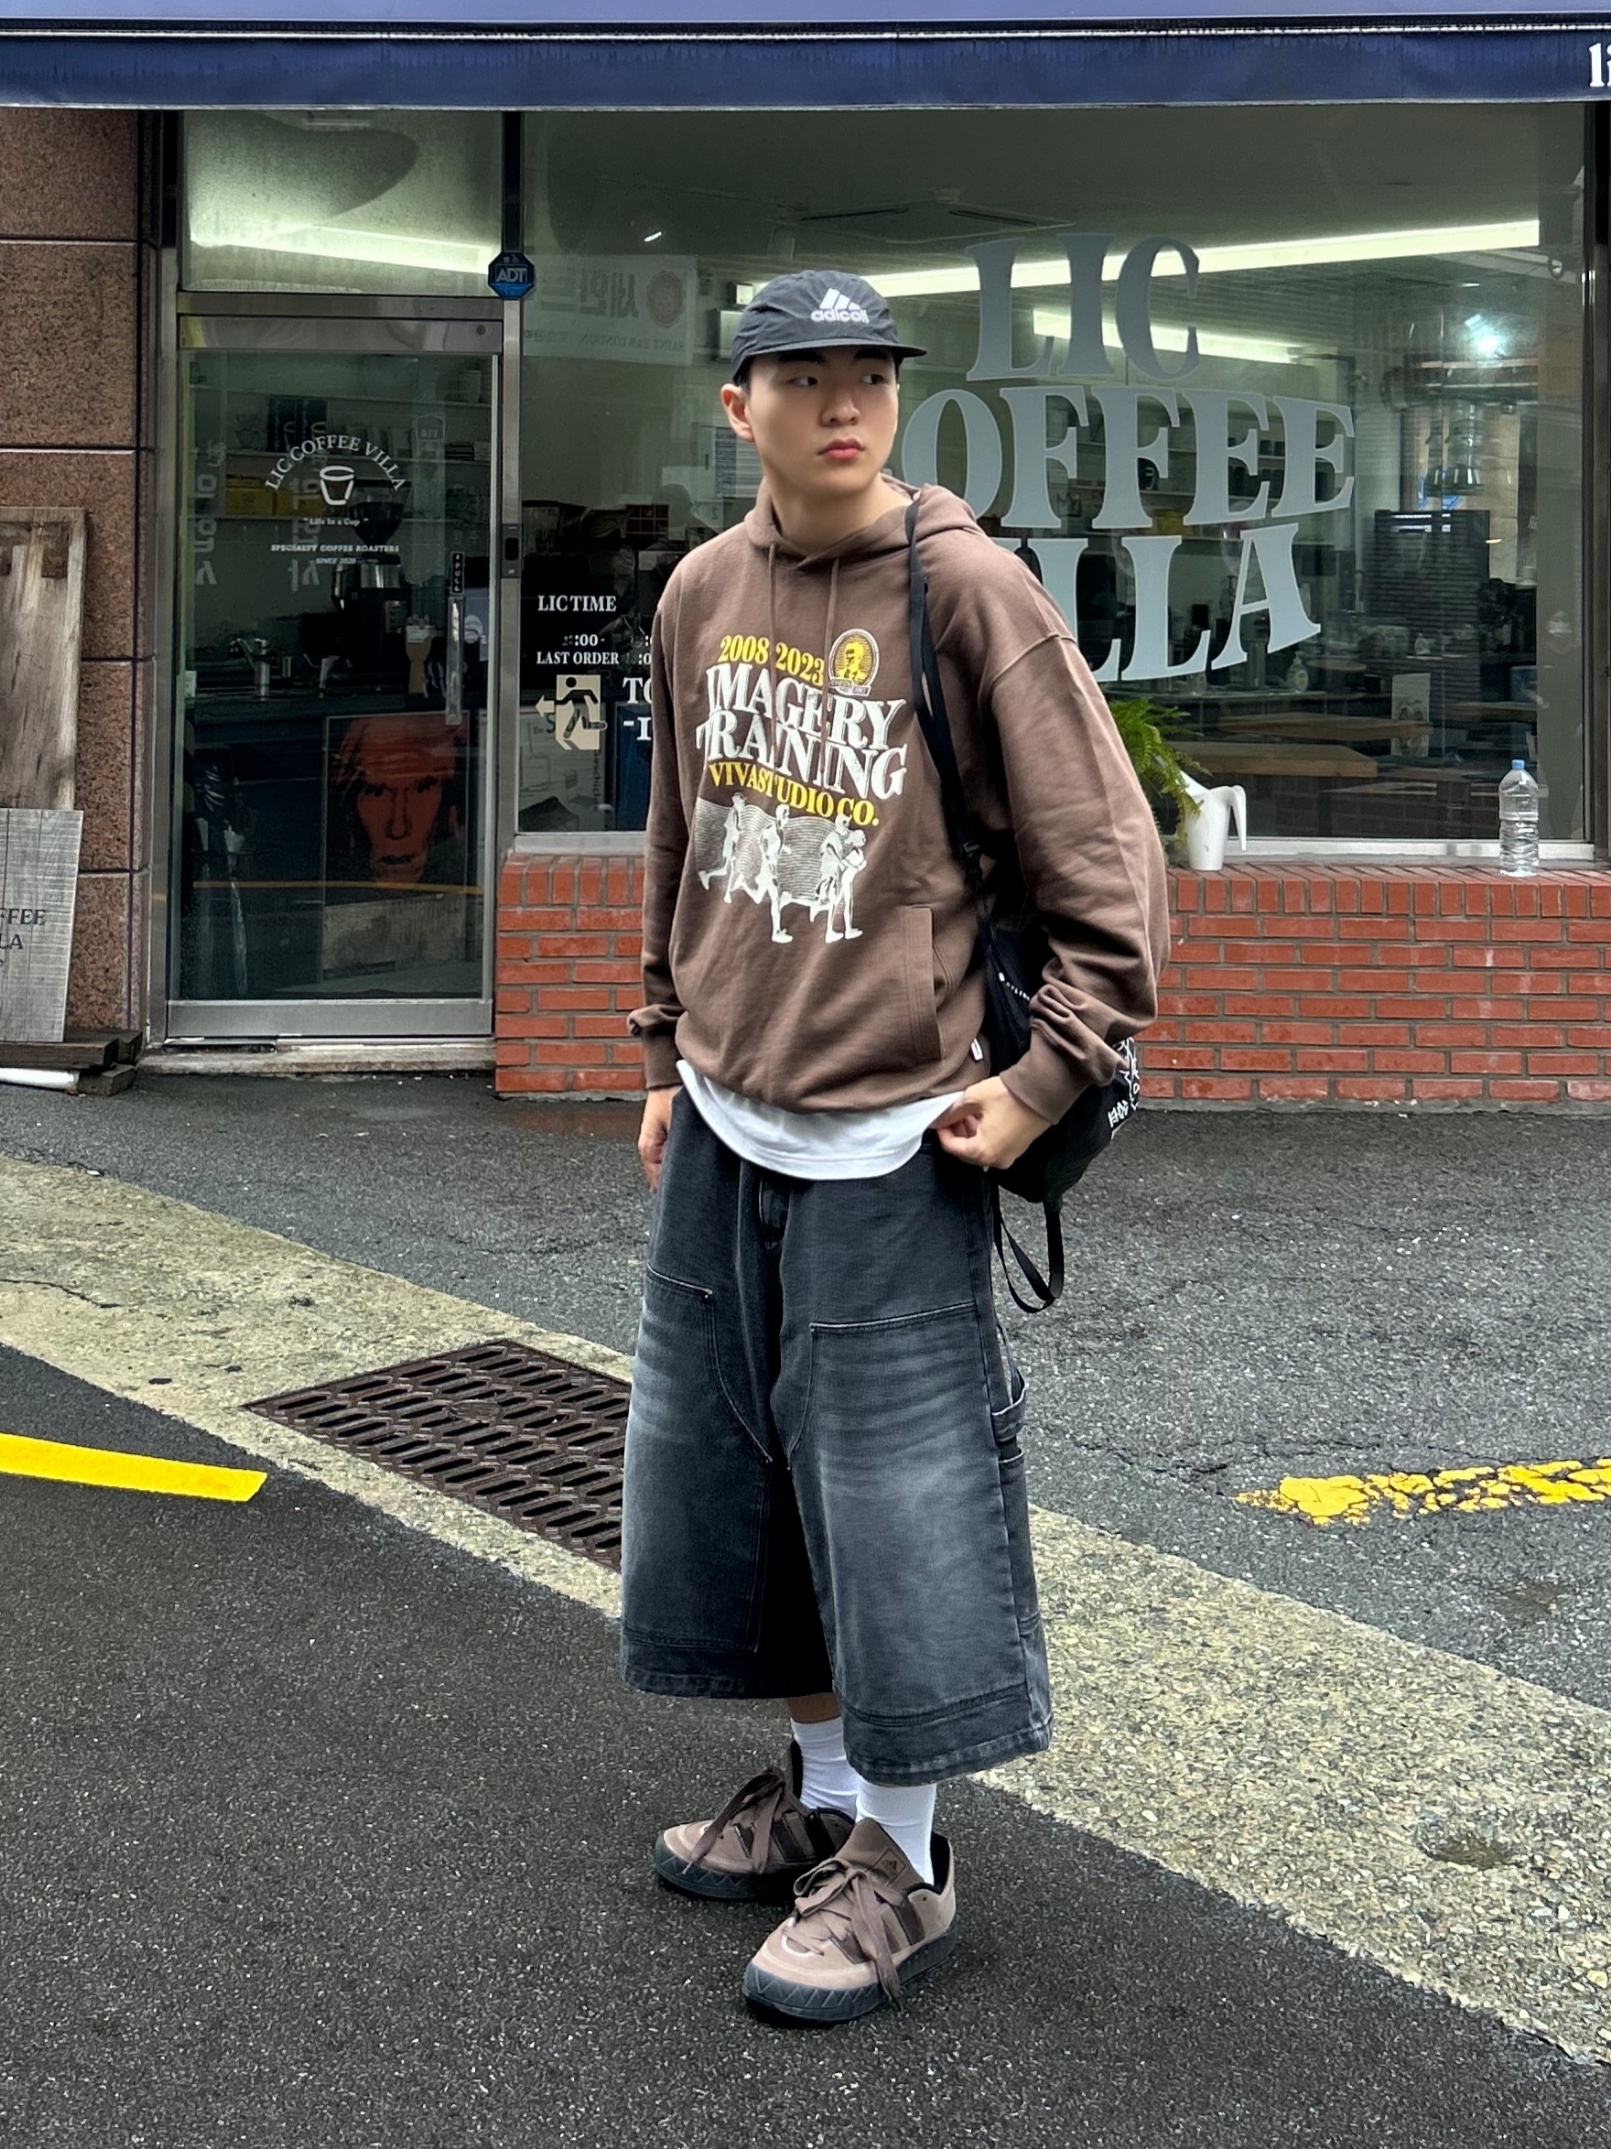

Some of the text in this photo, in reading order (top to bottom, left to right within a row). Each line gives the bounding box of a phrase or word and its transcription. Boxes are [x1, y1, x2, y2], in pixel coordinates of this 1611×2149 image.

[496, 267, 528, 283] ADT
[965, 233, 1200, 382] LIC
[265, 457, 293, 490] LIC
[290, 434, 361, 461] COFFEE
[363, 442, 406, 491] VILLA
[270, 544, 400, 552] SPECIALTY COFFEE ROASTERS
[536, 651, 570, 665] LAST
[572, 651, 620, 665] ORDER
[717, 634, 770, 665] 2008
[774, 642, 825, 687] 2023
[705, 662, 907, 751] IMAGERY
[708, 760, 880, 827] VIVASTUDIO CO.
